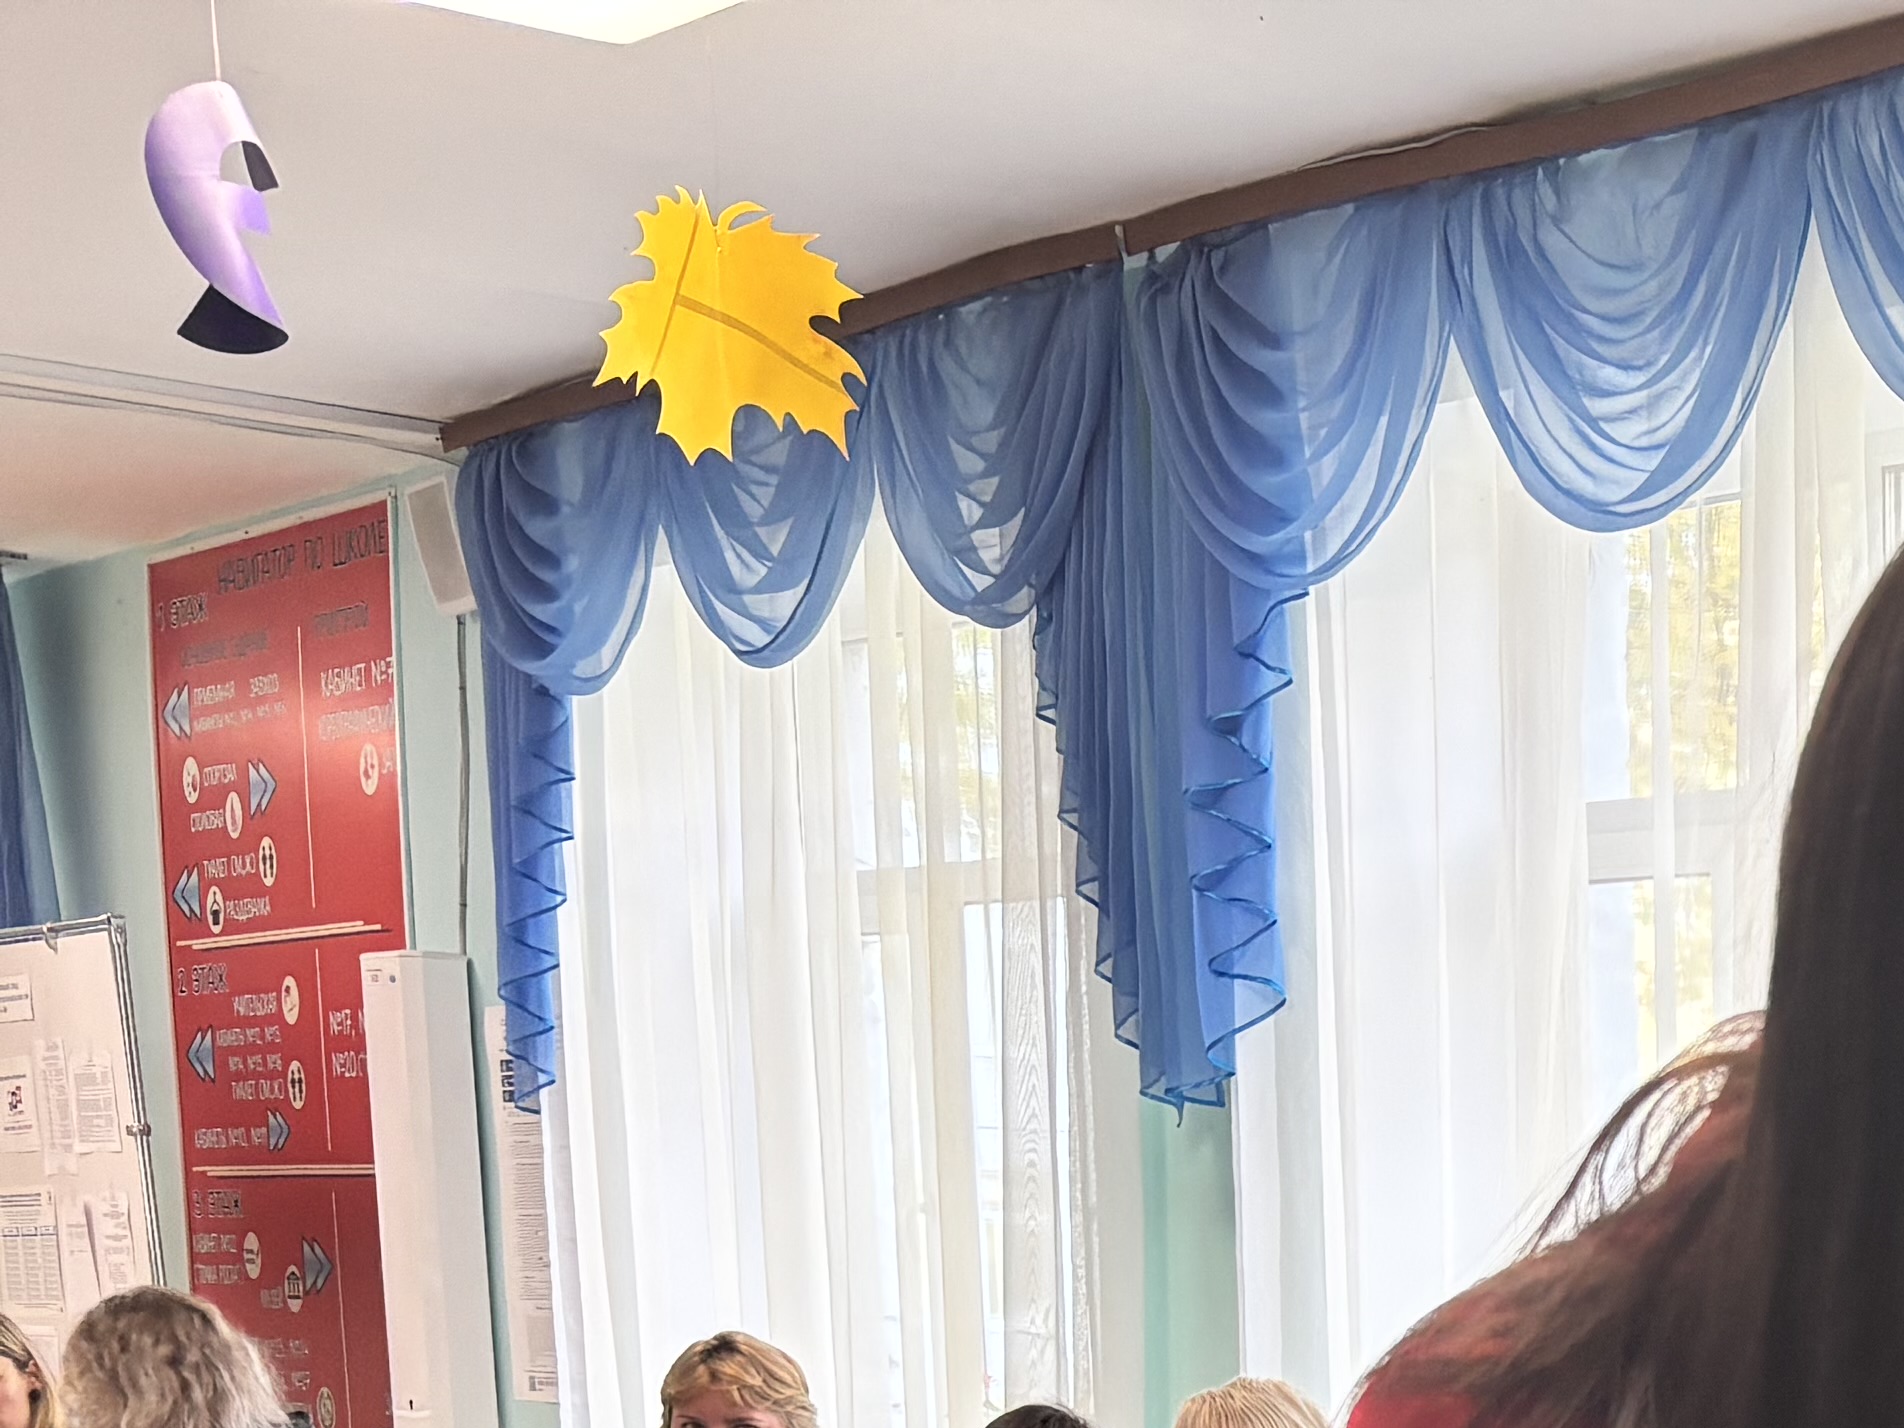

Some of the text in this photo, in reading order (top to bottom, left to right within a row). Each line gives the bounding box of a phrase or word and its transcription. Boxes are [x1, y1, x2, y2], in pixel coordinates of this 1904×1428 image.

[332, 519, 388, 567] ШКОЛЕ
[177, 963, 229, 996] 2 ЭТАЖ
